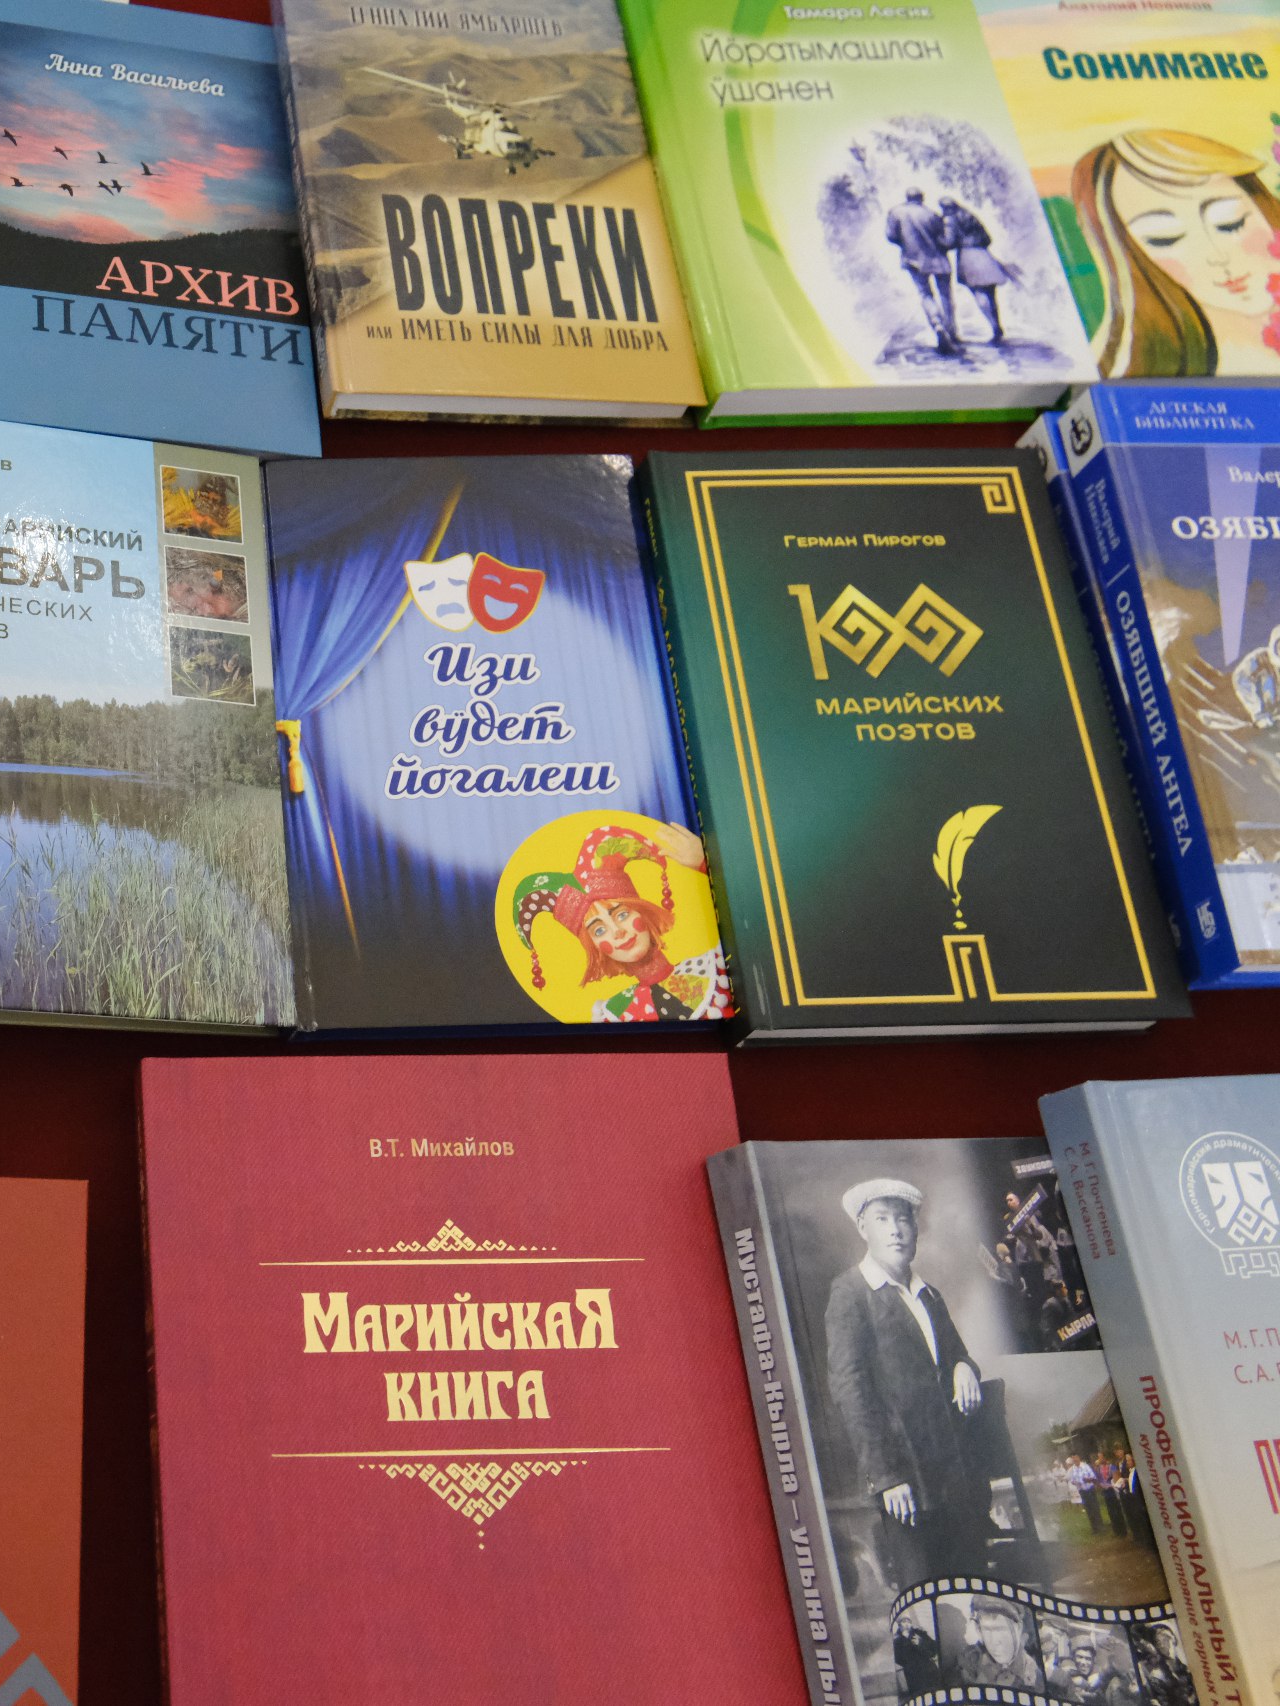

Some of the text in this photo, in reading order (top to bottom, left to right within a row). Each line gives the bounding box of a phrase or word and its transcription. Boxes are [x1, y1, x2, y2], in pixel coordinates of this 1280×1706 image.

[783, 5, 863, 21] Тамара
[45, 53, 225, 97] Анна Васильева
[1042, 46, 1269, 80] Сонимаке
[381, 193, 659, 323] ВОПРЕКИ
[96, 256, 300, 316] АРХИВ
[32, 295, 304, 365] ПАМЯТИ
[401, 318, 472, 342] ИМЕТЬ
[482, 321, 542, 345] СИЛЫ
[552, 324, 593, 347] ДЛЯ
[604, 328, 669, 351] ДОБРА
[426, 644, 538, 695] Изи
[815, 692, 1004, 715] МАРИЙСКИХ
[1116, 590, 1168, 749] ОЗЯБШИЙ
[1155, 754, 1192, 857] АНГЕЛ
[856, 723, 976, 742] ПОЭТОВ
[369, 1136, 515, 1159] В.Т. Михайлов
[384, 1370, 551, 1422] КНИГА
[1140, 1433, 1171, 1531] культурное
[1139, 1374, 1238, 1681] ПРОФЕССИОНАЛЬНЫЙ
